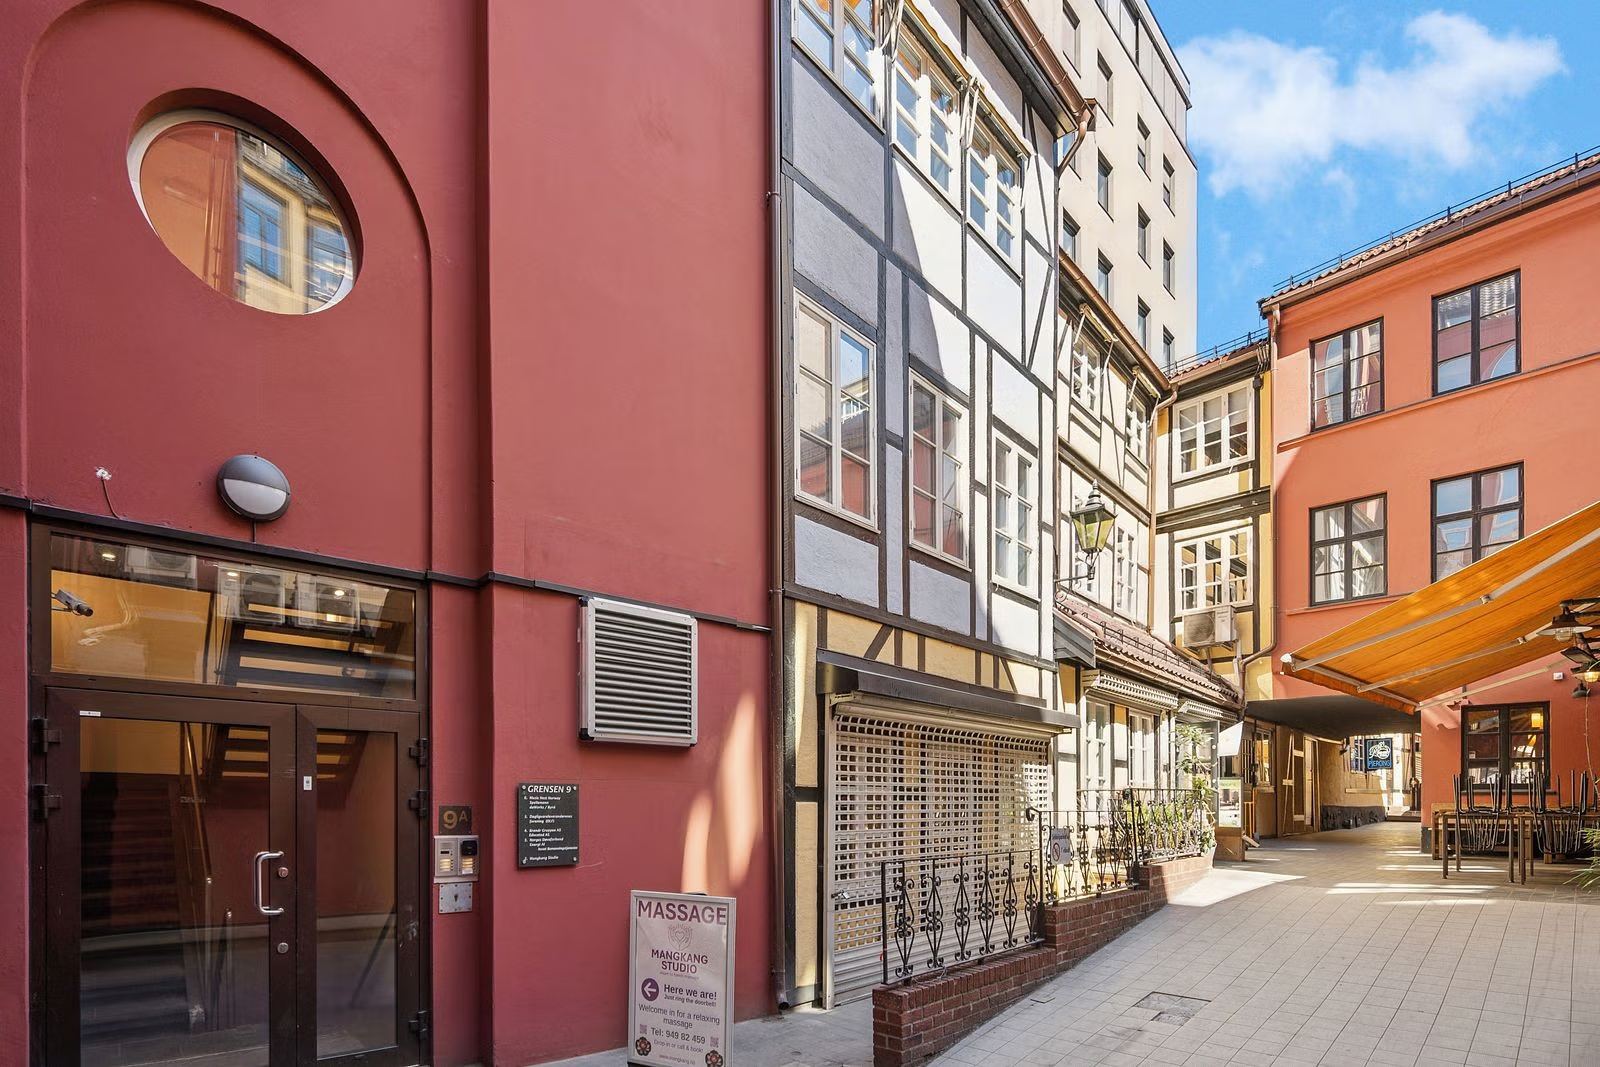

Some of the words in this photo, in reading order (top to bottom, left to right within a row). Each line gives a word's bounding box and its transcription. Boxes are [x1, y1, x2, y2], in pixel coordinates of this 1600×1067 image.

[527, 784, 564, 793] GRENSEN
[566, 785, 572, 794] 9
[638, 900, 727, 926] MASSAGE
[651, 949, 708, 965] MANGKANG
[661, 961, 697, 974] STUDIO
[664, 984, 683, 995] Here
[686, 989, 697, 997] we
[700, 991, 717, 1000] are!
[639, 1003, 667, 1016] Welcome
[669, 1007, 675, 1016] in
[677, 1010, 685, 1018] for
[693, 1012, 720, 1025] relaxing
[663, 1017, 693, 1029] massage
[651, 1027, 664, 1037] Tel:
[666, 1030, 679, 1040] 949
[681, 1032, 690, 1042] 82
[692, 1035, 705, 1045] 459
